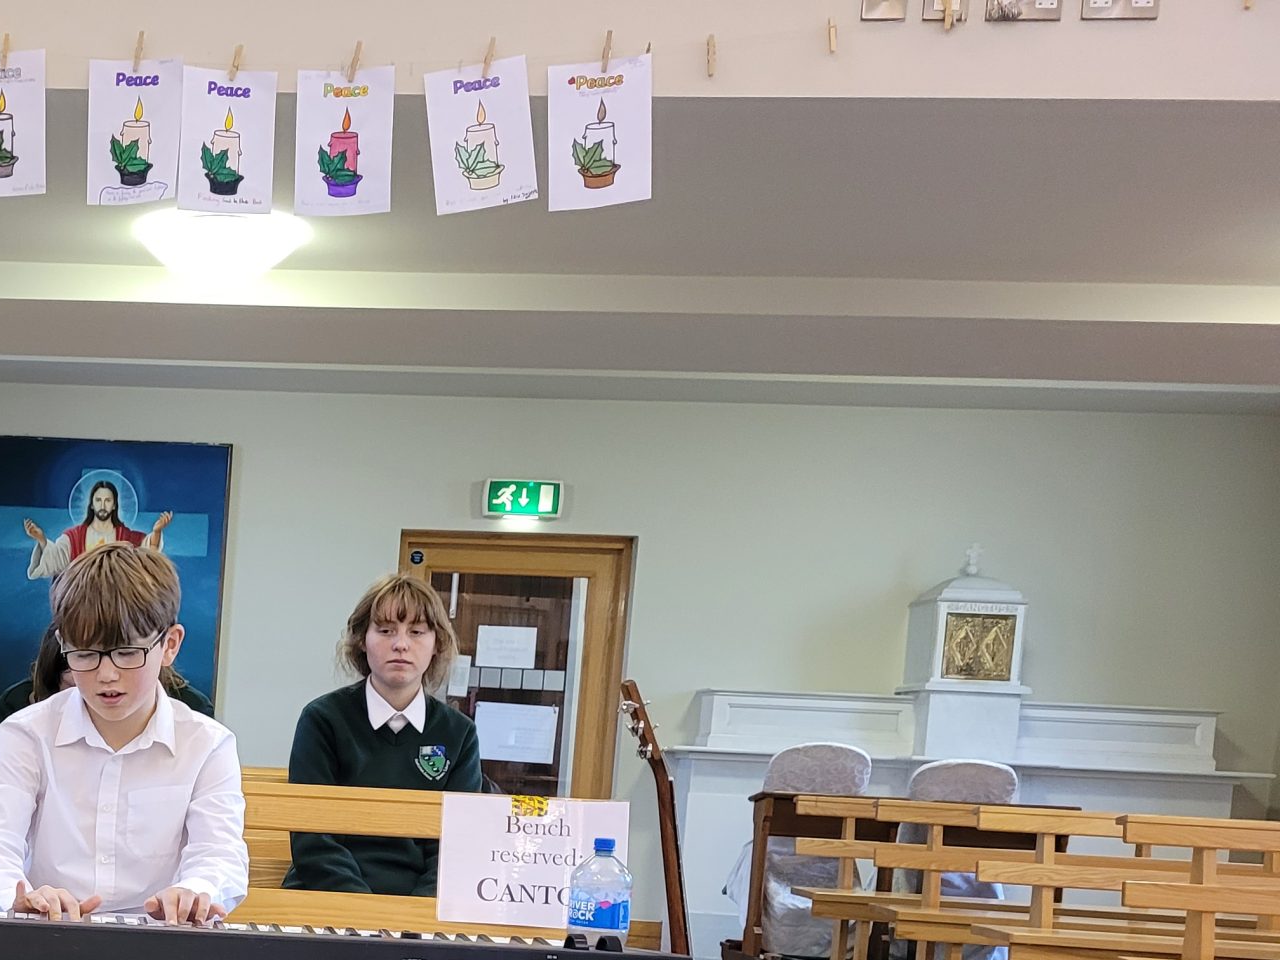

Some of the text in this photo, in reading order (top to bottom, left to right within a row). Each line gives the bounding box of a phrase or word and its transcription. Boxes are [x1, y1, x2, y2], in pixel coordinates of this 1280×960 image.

[115, 72, 160, 87] Peace
[453, 76, 501, 94] Peace
[576, 74, 624, 90] Peace
[207, 80, 251, 98] Peace
[323, 83, 369, 98] Peace
[505, 815, 571, 837] Bench
[569, 900, 595, 911] IVER
